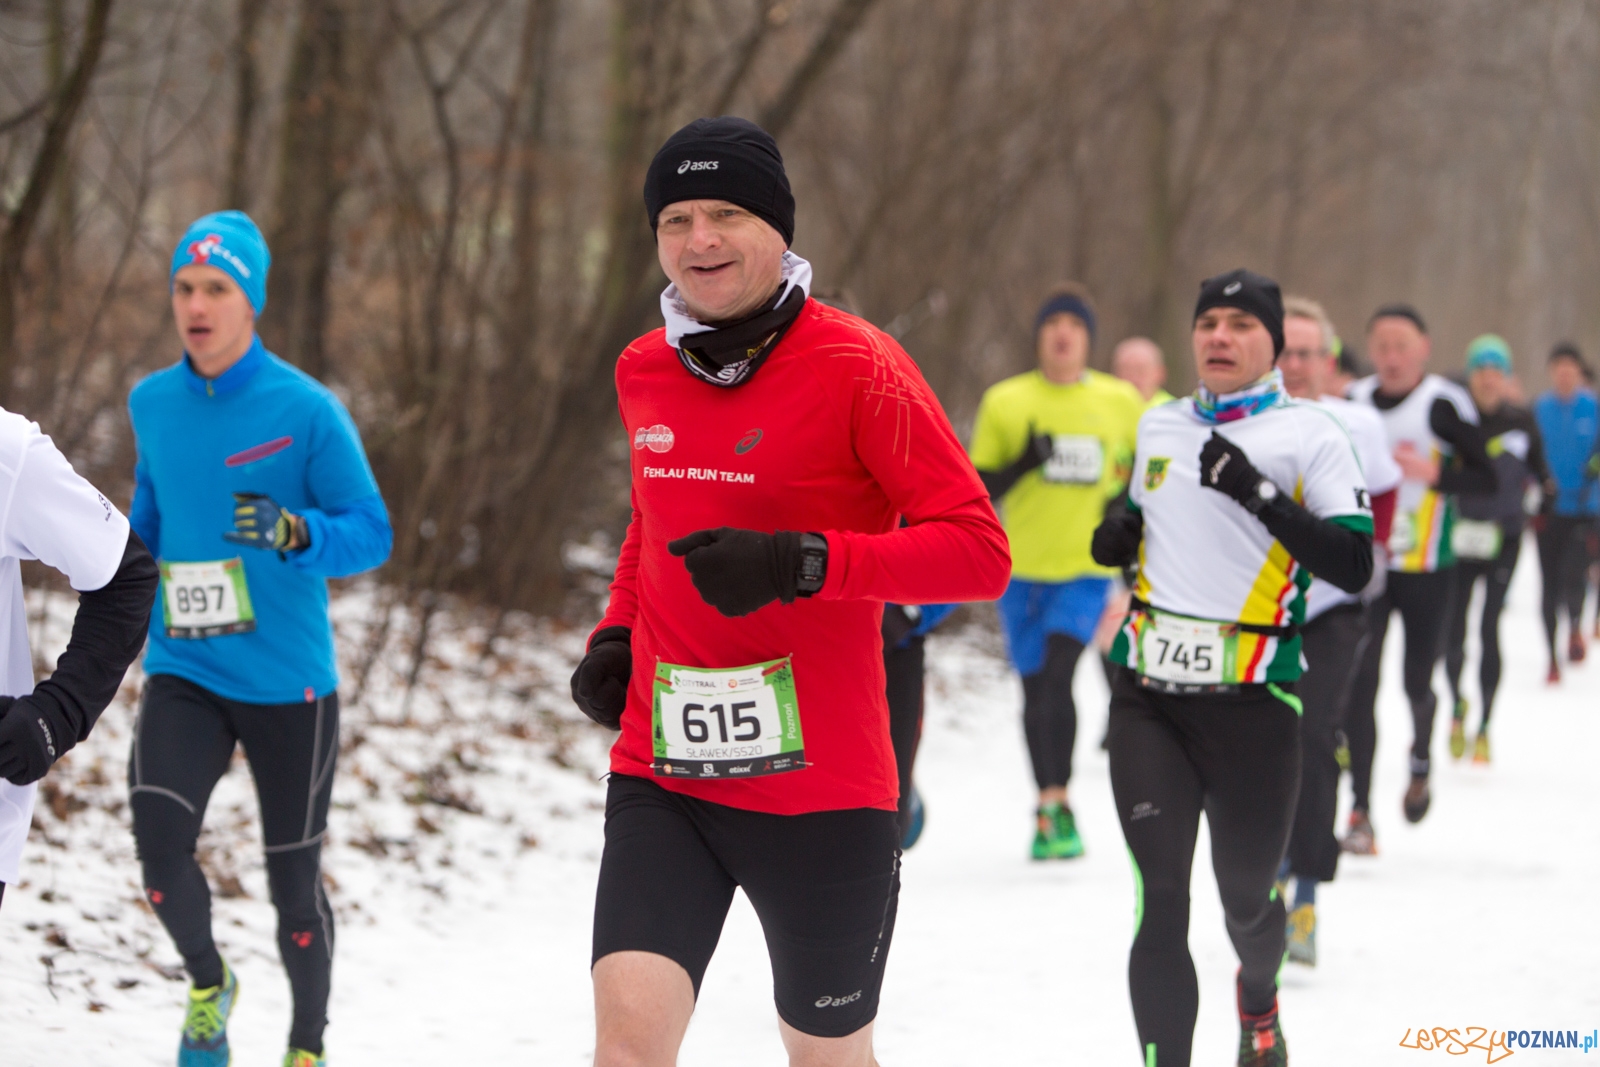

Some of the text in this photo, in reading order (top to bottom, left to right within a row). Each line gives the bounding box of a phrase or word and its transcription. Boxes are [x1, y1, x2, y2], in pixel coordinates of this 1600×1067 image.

[690, 161, 719, 171] asics
[643, 466, 755, 484] FEHLAU RUN TEAM
[176, 585, 224, 613] 897
[1157, 637, 1213, 672] 745
[682, 700, 762, 744] 615
[782, 703, 797, 740] Poznań
[831, 989, 862, 1007] asics
